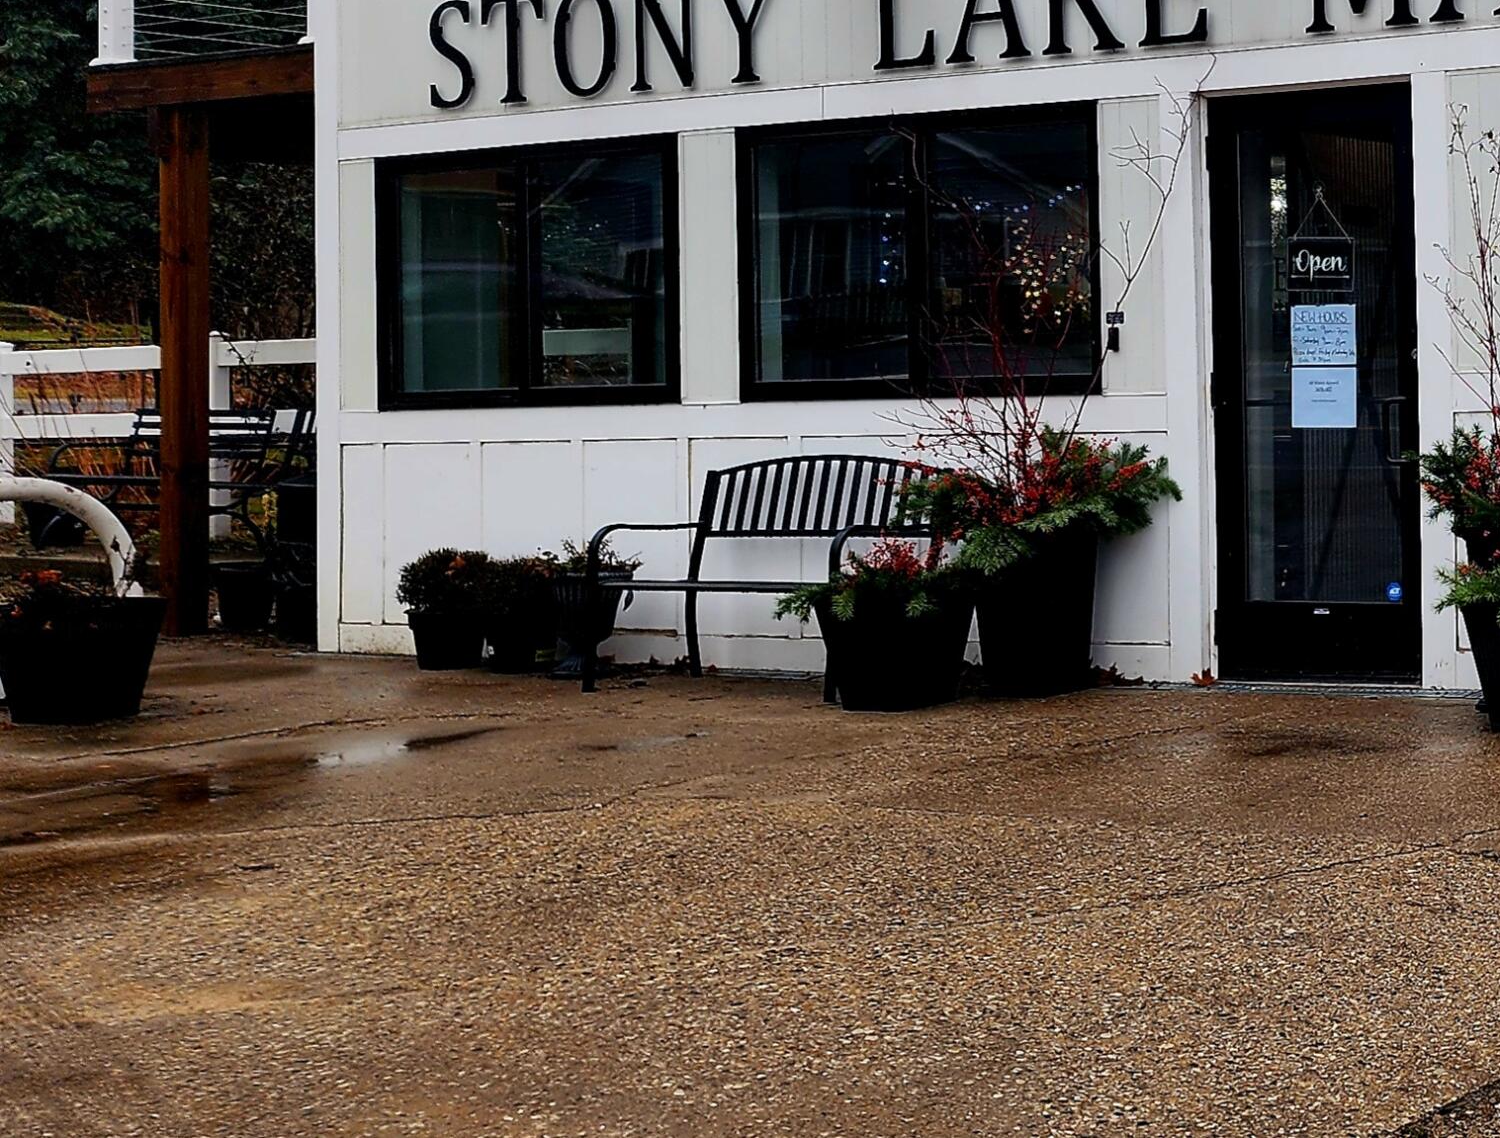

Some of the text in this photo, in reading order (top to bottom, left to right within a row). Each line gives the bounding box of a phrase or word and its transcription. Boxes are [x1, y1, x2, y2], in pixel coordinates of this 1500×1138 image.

[1295, 249, 1347, 282] Open
[1294, 310, 1348, 323] NEW HOURS
